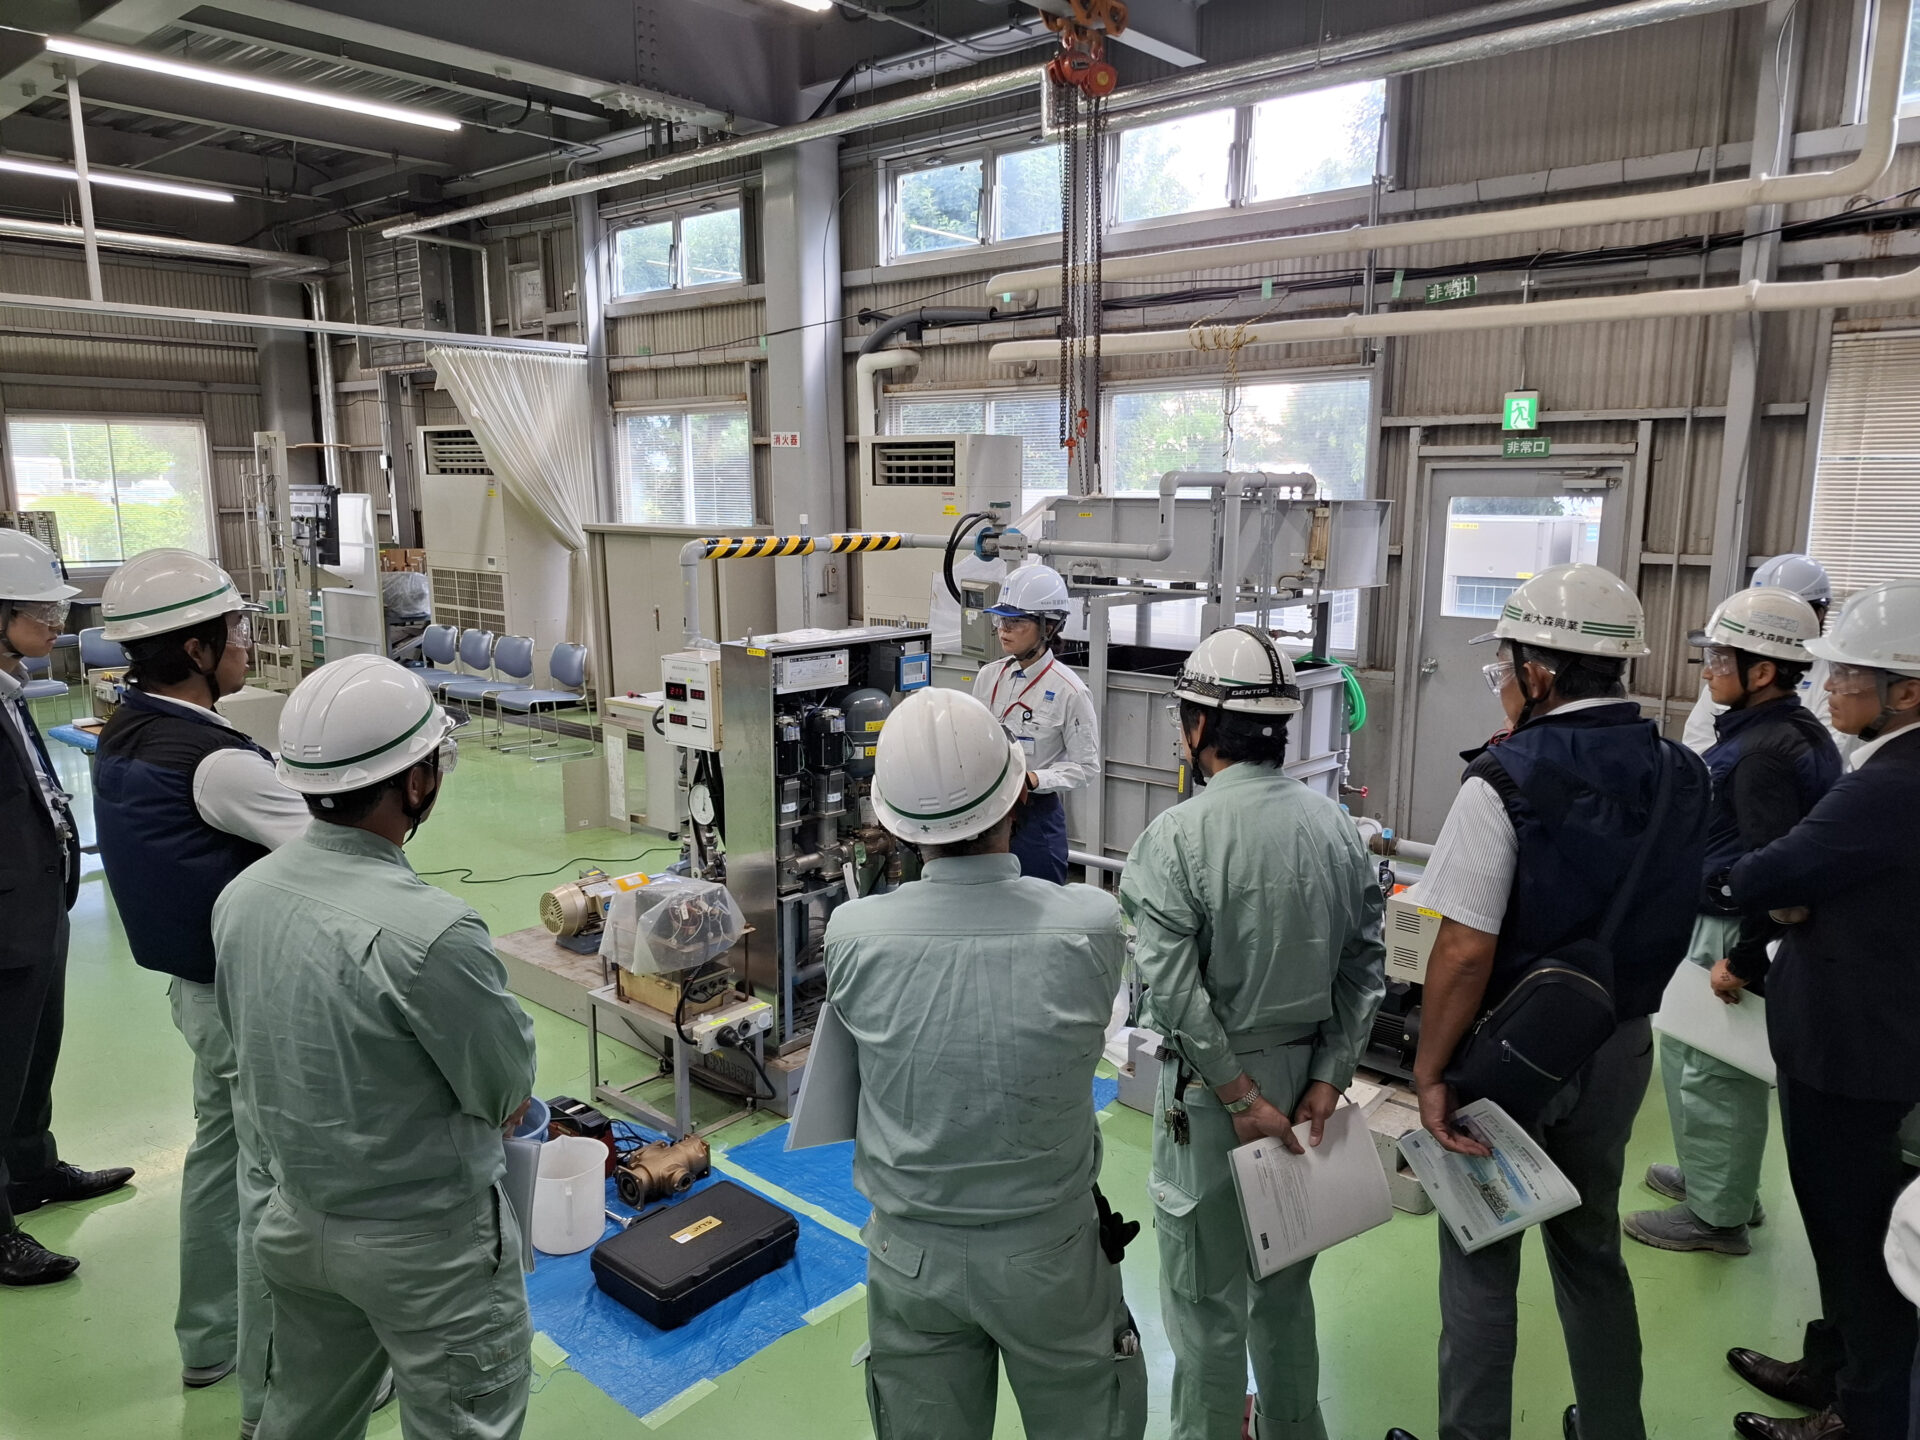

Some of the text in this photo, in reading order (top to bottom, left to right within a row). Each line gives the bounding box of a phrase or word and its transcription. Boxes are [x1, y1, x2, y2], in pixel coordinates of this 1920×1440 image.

[774, 434, 798, 446] 消火器
[1507, 440, 1545, 454] 非常口
[1269, 649, 1281, 684] GENTOS
[1231, 687, 1270, 696] GENTOS
